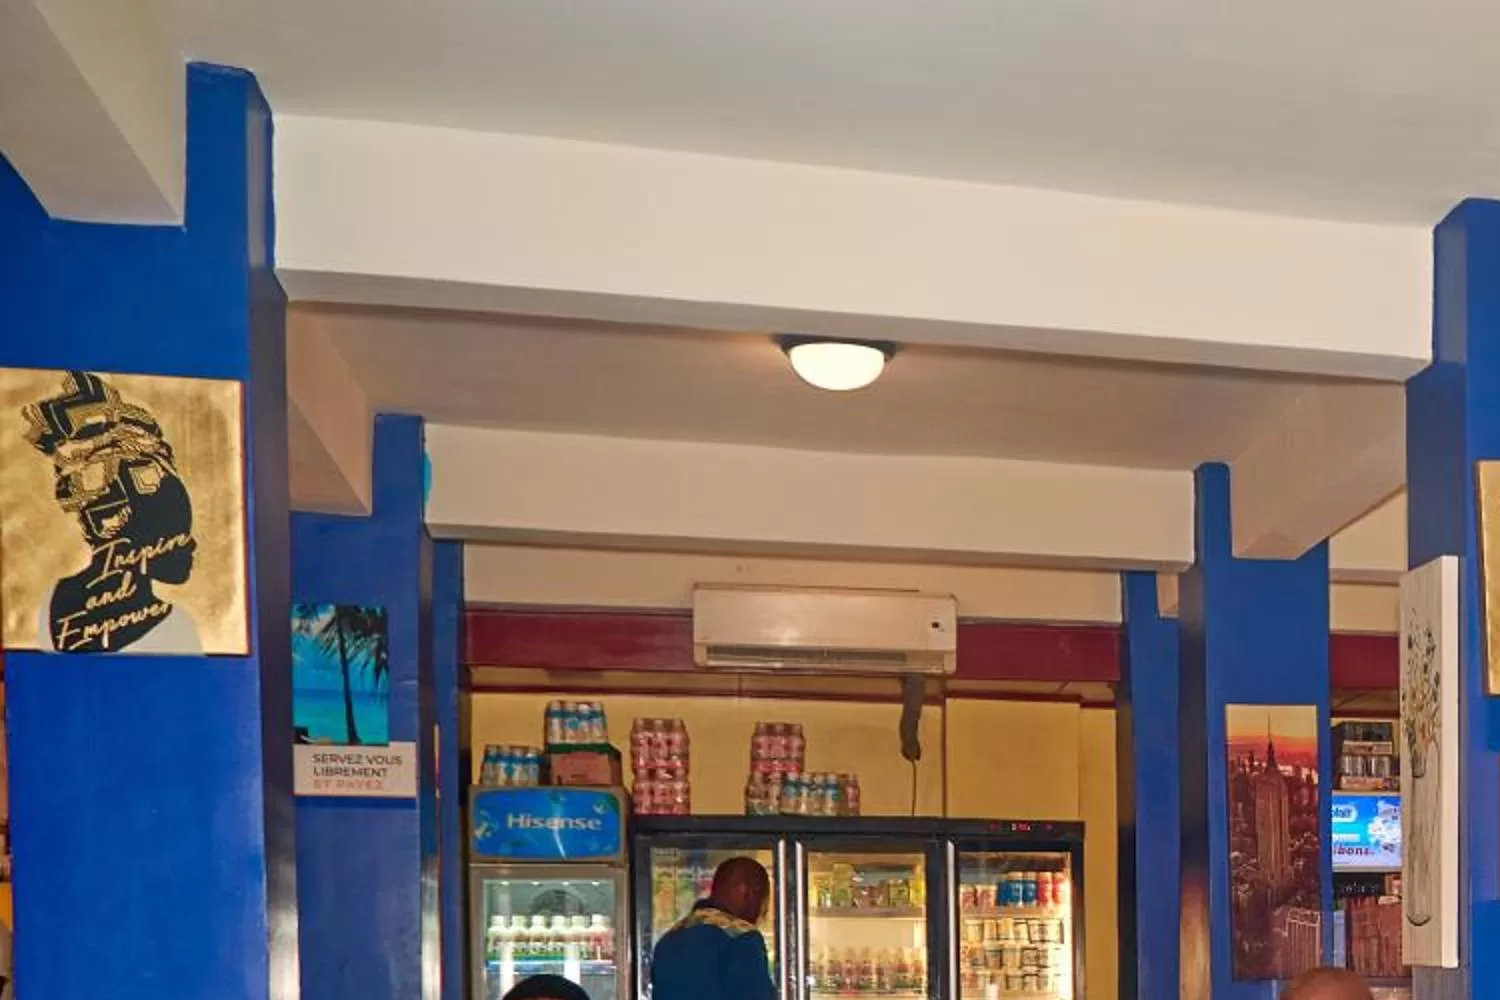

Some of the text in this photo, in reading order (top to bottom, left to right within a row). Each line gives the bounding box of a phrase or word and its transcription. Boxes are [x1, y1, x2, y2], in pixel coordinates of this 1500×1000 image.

[87, 533, 194, 588] Inspire
[86, 571, 136, 609] and
[56, 602, 172, 650] Empower
[312, 753, 403, 765] SERVEZ VOUS
[313, 767, 388, 777] LIBREMENT
[313, 779, 384, 790] ET PAYEZ
[506, 812, 603, 831] Hisense
